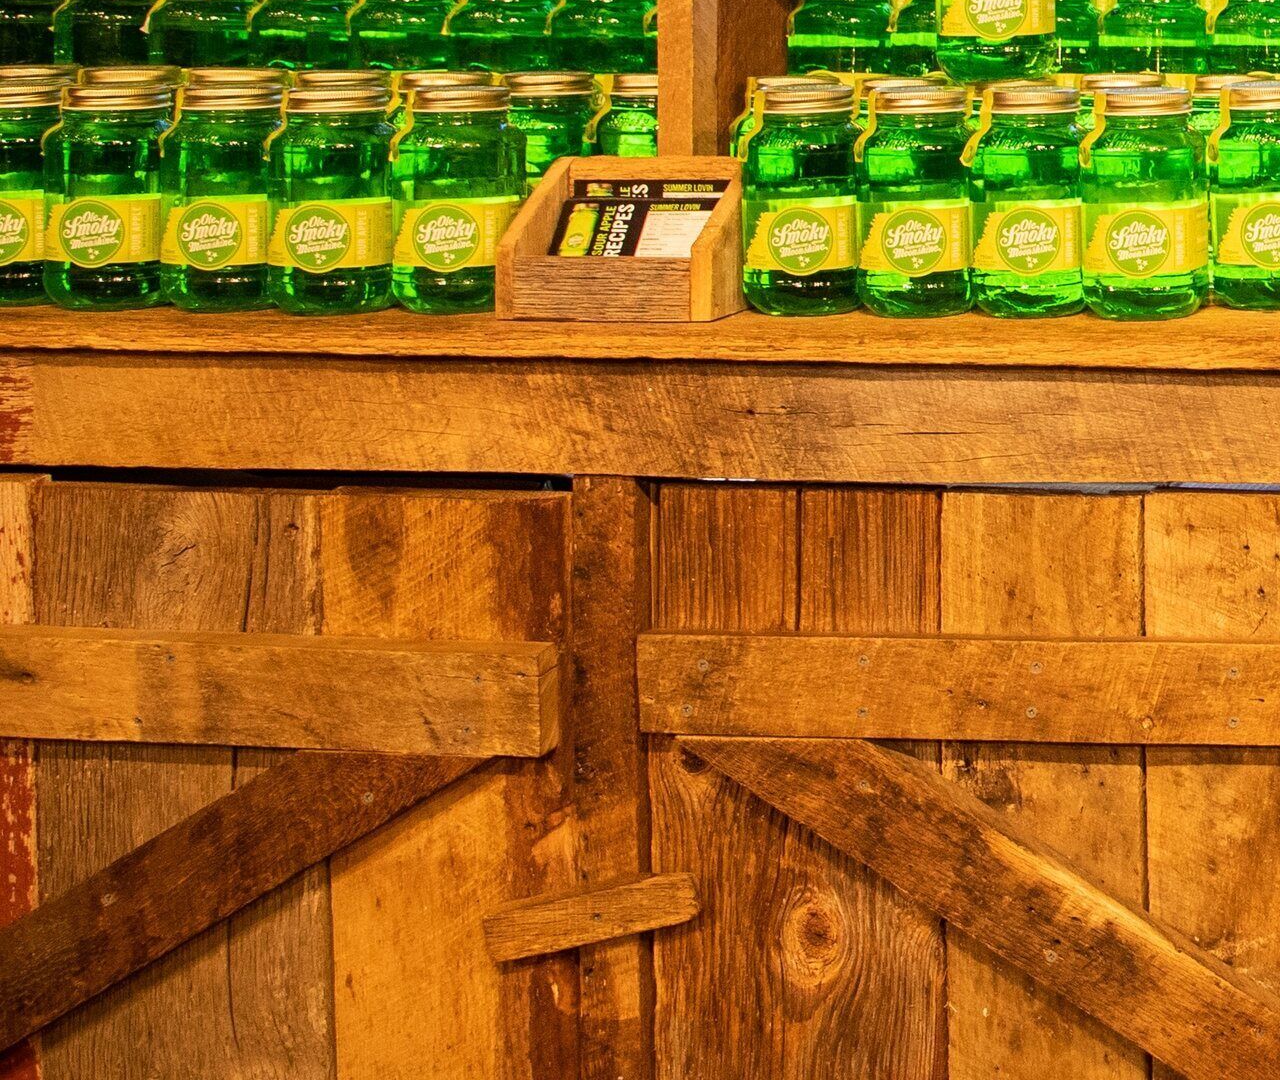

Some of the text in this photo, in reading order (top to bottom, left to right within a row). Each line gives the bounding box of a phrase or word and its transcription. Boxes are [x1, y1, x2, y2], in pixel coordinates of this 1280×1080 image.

[663, 184, 692, 192] SUMMER
[82, 211, 102, 223] Ole
[200, 215, 219, 226] Ole
[308, 216, 328, 228] Ole
[437, 215, 458, 227] Ole
[64, 215, 121, 239] Smoky
[181, 218, 237, 241] Smoky
[417, 219, 477, 243] Smoky
[592, 206, 617, 256] SOUR APPLE
[603, 204, 634, 257] RECIPES
[791, 219, 811, 231] Ole
[905, 220, 925, 232] Ole
[1019, 219, 1039, 231] Ole
[1129, 222, 1149, 234] Ole
[289, 220, 348, 244] Smoky
[773, 223, 830, 247] Smoky
[887, 224, 944, 248] Smoky
[1001, 223, 1058, 247] Smoky
[1111, 226, 1168, 250] Smoky
[71, 237, 119, 250] Moonshine
[188, 240, 235, 253] Moonshine
[296, 242, 346, 255] Moonshine
[425, 241, 475, 254] Moonshine
[780, 245, 828, 258] Moonshine
[894, 246, 942, 259] Moonshine
[1008, 245, 1056, 258] Moonshine
[1118, 248, 1166, 261] Moonshine
